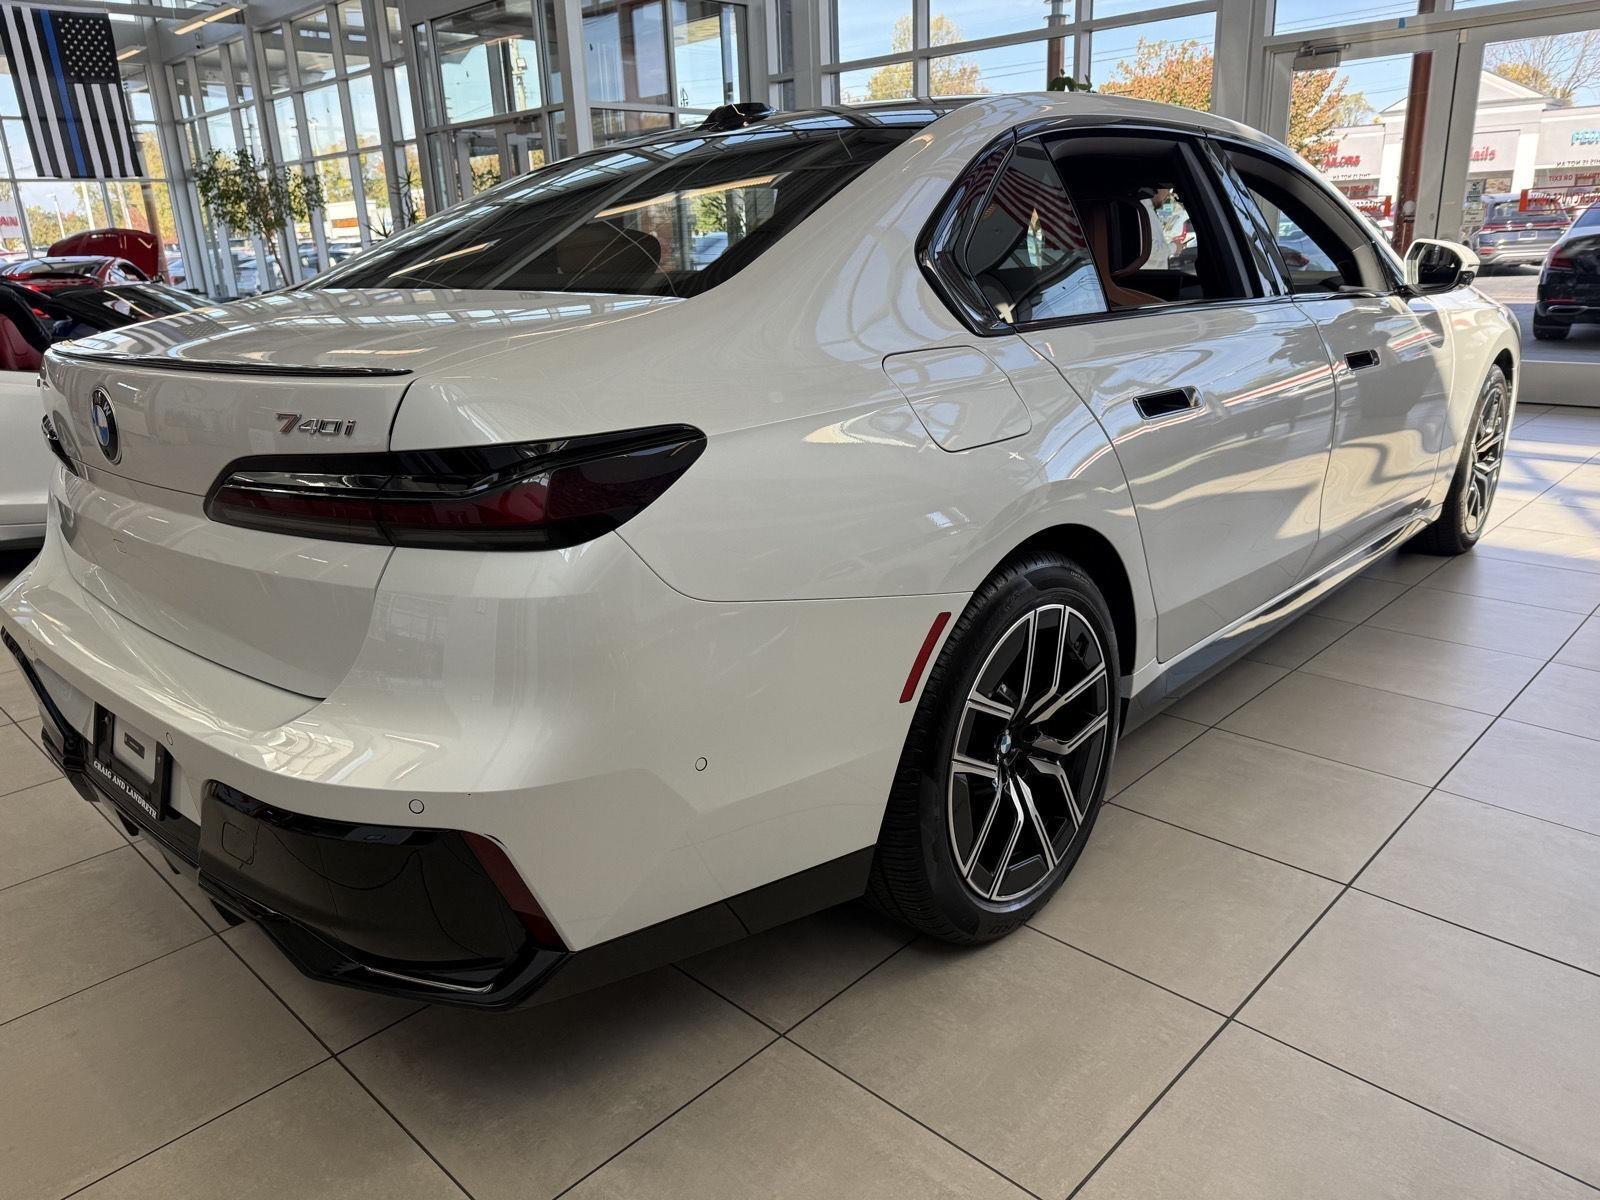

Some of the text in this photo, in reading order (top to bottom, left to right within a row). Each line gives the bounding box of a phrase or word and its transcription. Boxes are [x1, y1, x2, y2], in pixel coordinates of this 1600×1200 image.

[275, 411, 357, 437] 740i
[93, 760, 157, 820] CRAIG AND LANDRETH
